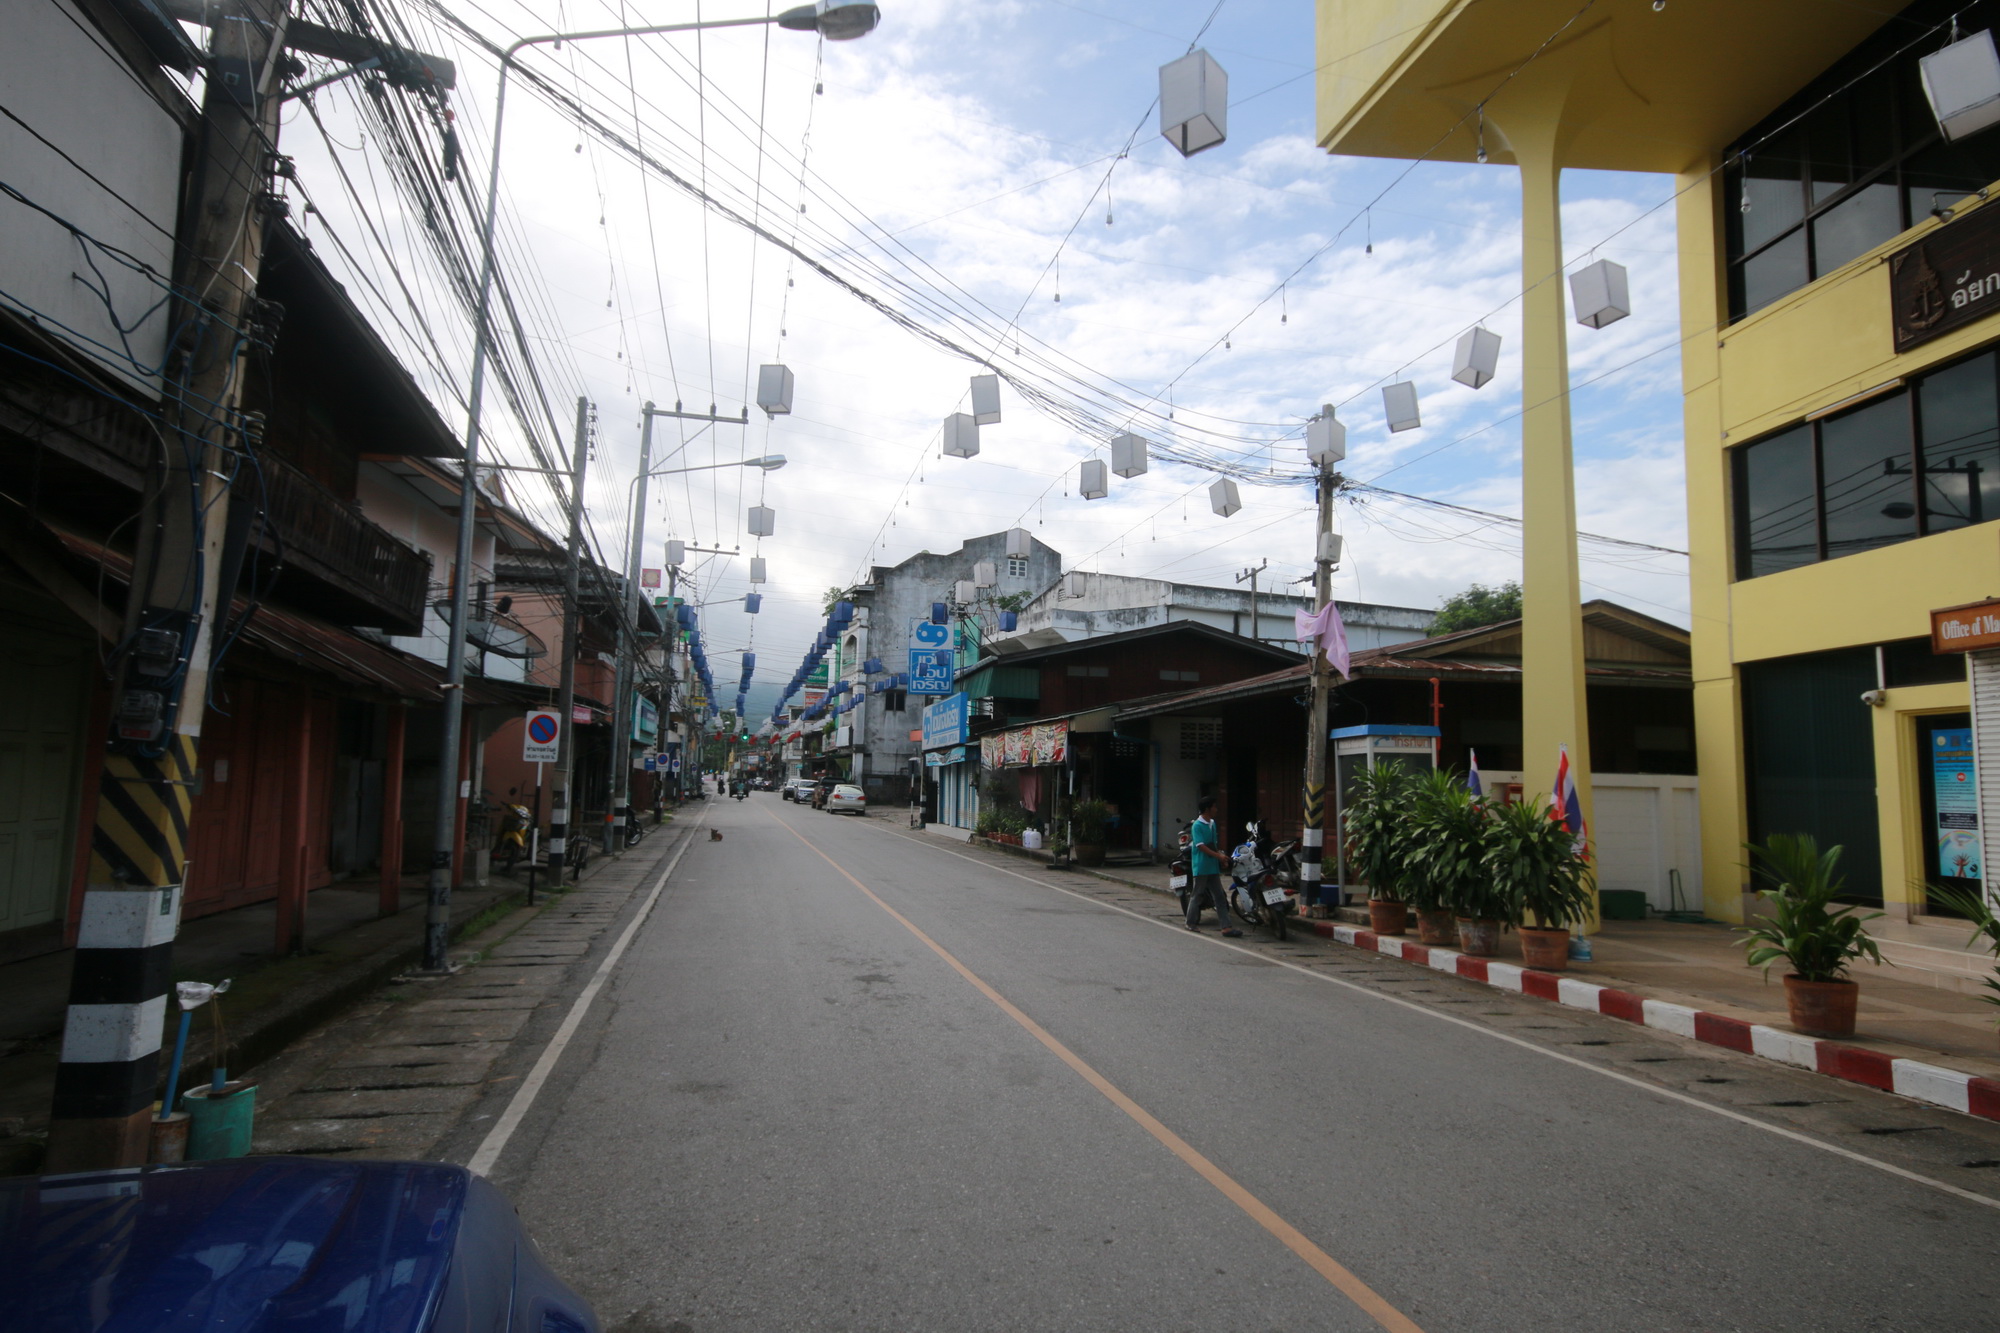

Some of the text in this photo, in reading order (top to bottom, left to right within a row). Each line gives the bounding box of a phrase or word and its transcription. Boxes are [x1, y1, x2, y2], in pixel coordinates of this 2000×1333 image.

[1951, 269, 2000, 309] อัยก
[1942, 620, 1970, 639] Office
[1972, 616, 1982, 635] of
[912, 678, 950, 690] เจริญ
